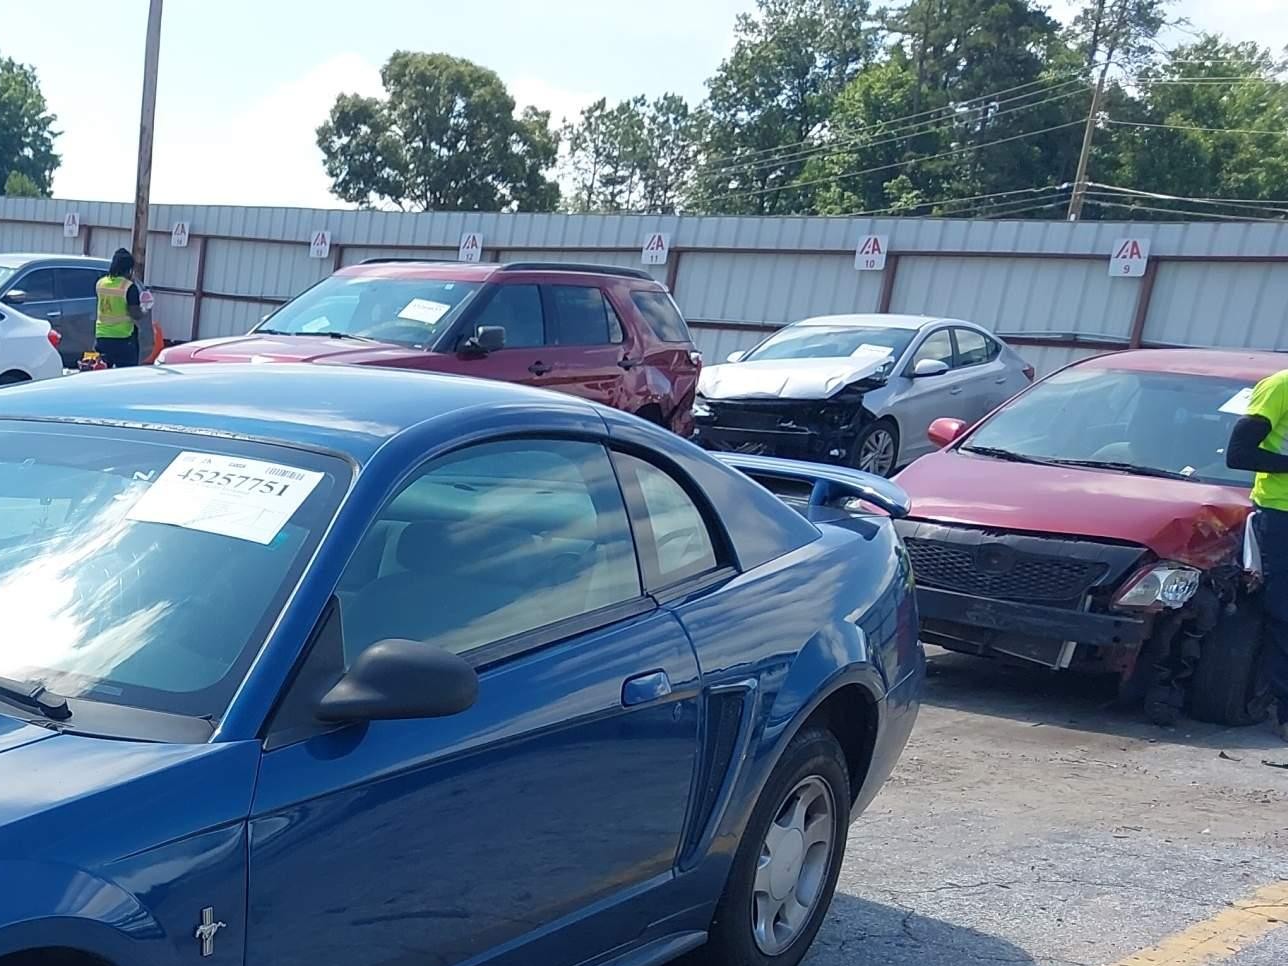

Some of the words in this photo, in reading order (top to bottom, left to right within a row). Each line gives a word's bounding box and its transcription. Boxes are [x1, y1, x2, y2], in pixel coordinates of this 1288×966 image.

[865, 259, 875, 269] 10
[1123, 264, 1130, 274] 9
[176, 467, 291, 497] 45257751
